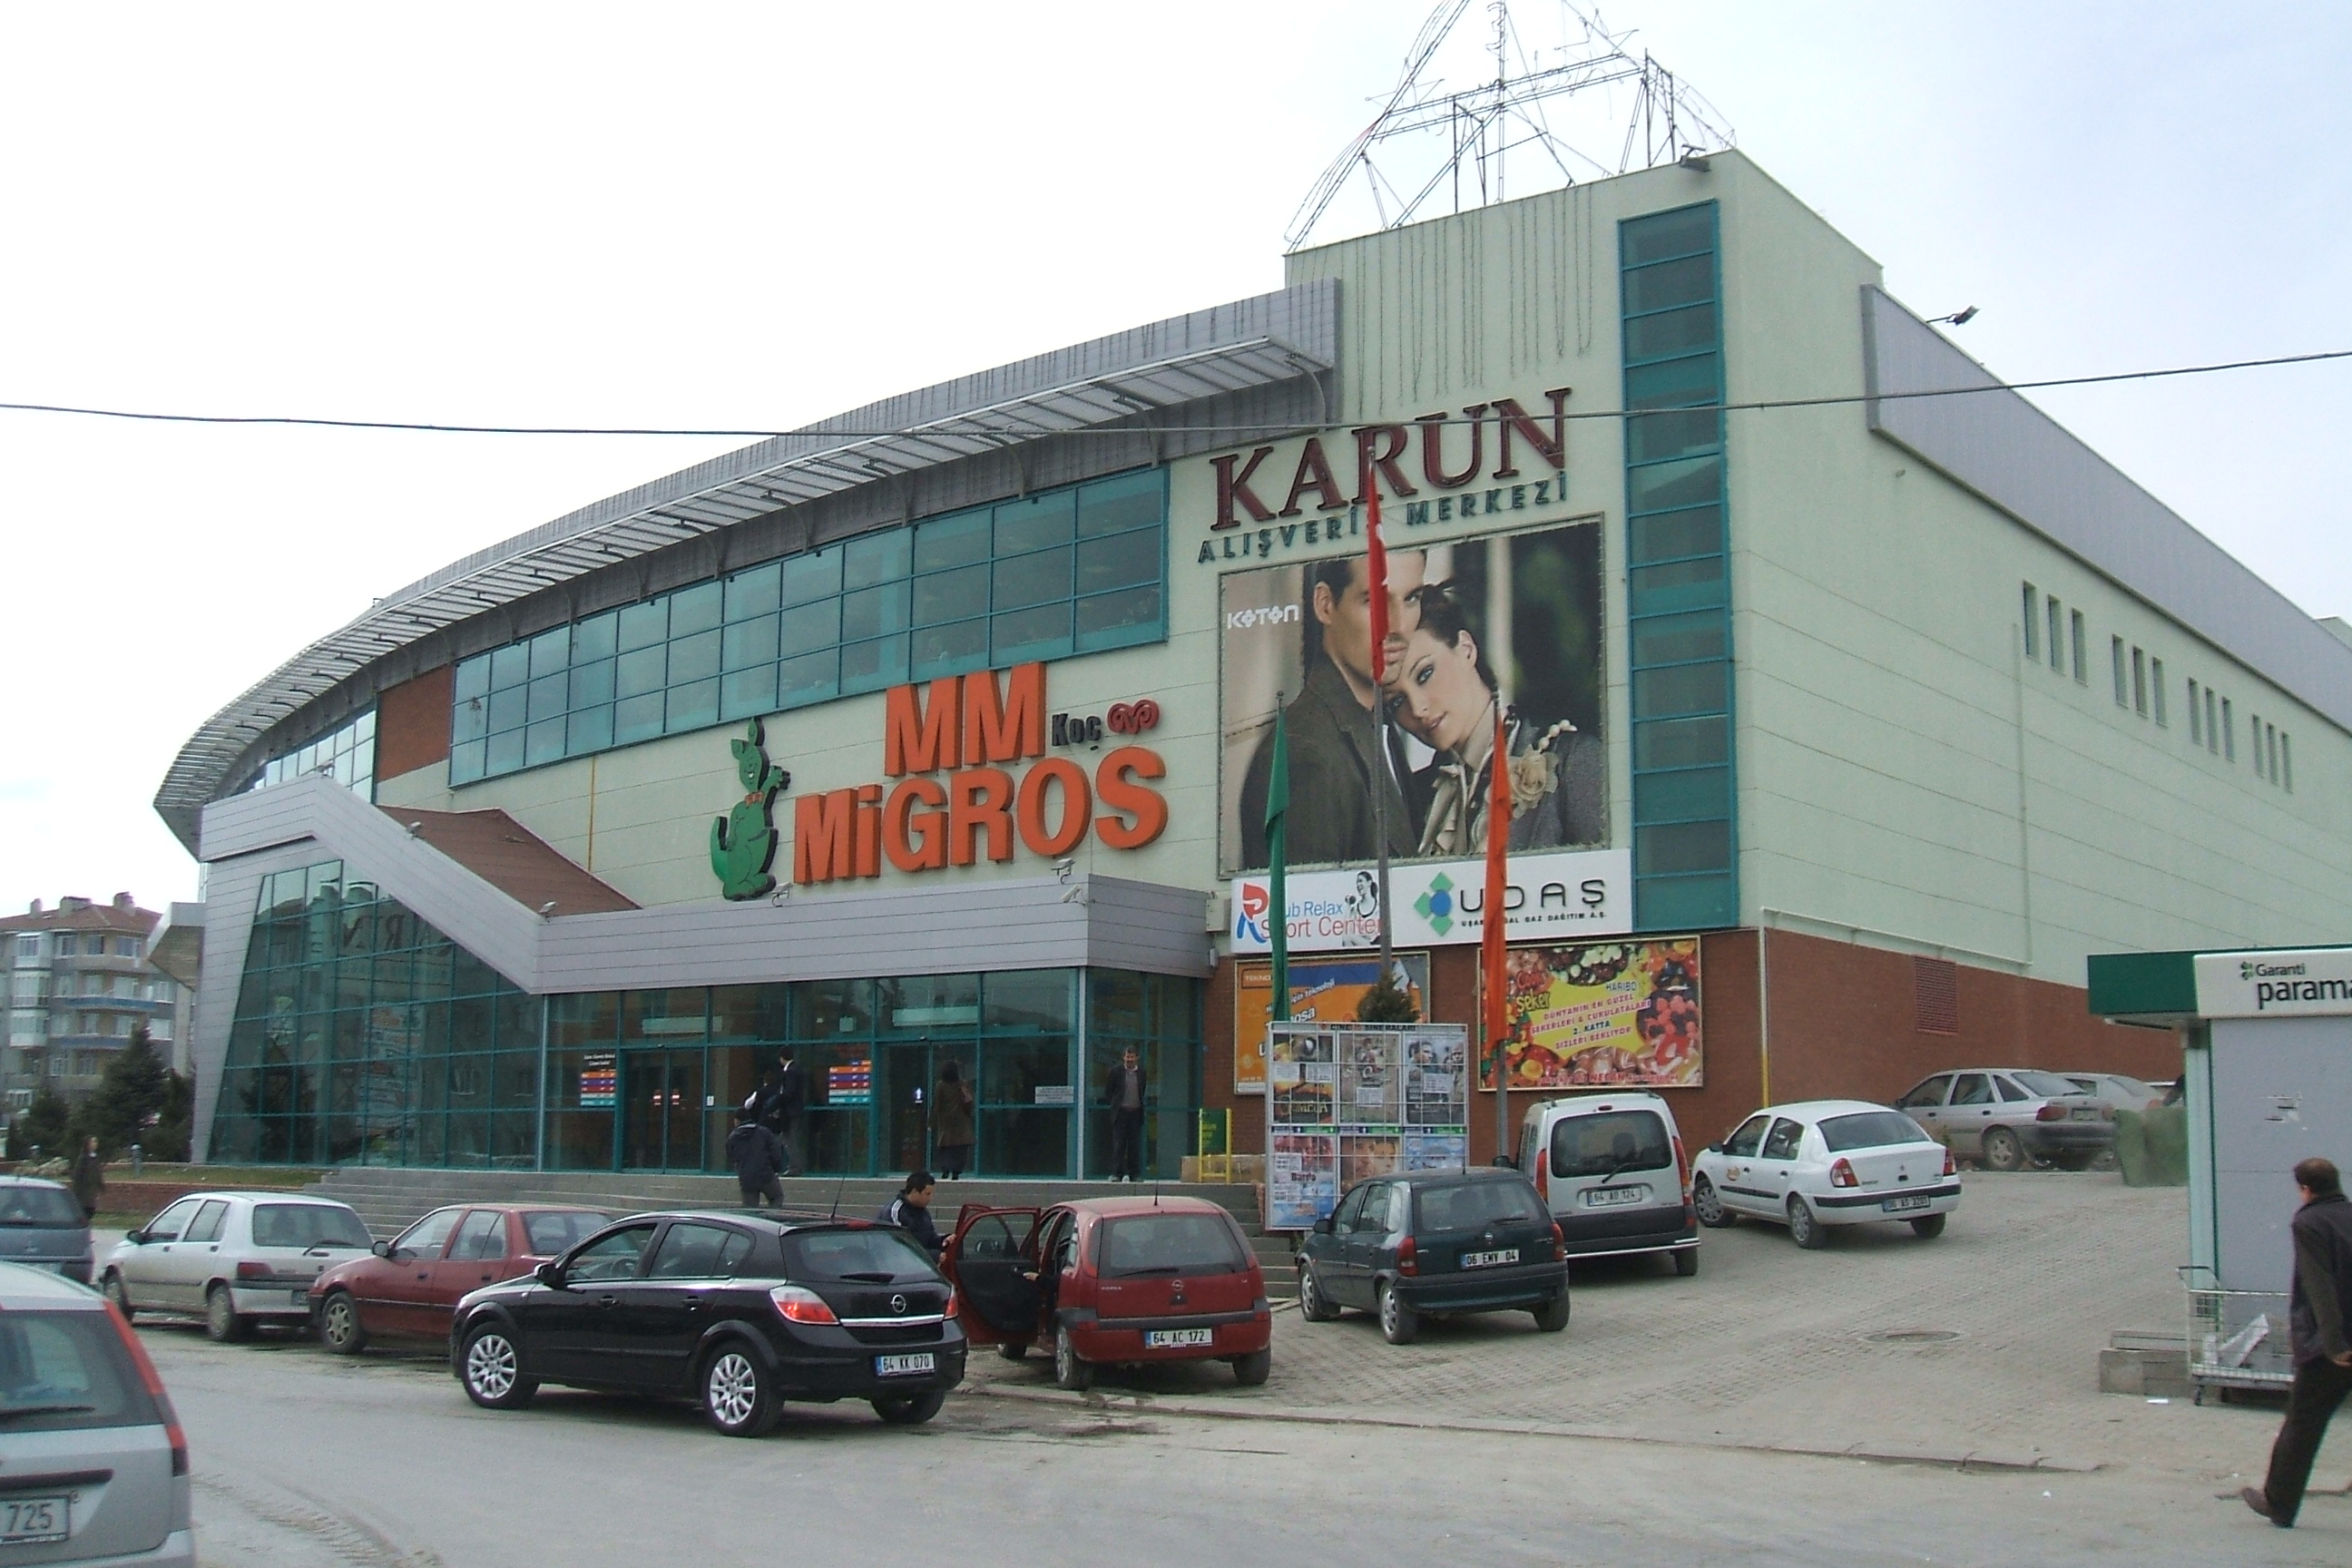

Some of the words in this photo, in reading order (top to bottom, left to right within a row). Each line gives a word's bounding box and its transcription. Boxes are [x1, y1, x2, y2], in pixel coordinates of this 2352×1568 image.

[1210, 387, 1573, 532] KARUN
[1198, 505, 1370, 564] ALIŞVERİ
[884, 661, 1046, 778] MM
[1051, 712, 1102, 751] Koç
[1304, 900, 1343, 916] Relax
[1260, 918, 1311, 939] Sort
[2256, 962, 2306, 977] Garanti
[1583, 1021, 1611, 1034] KATTA
[1466, 1254, 1477, 1266] 06
[1505, 1250, 1516, 1261] 04
[1153, 1333, 1165, 1344] 64
[1171, 1331, 1184, 1343] AC
[1189, 1330, 1205, 1342] 172
[883, 1357, 895, 1371] 64
[899, 1355, 910, 1369] KK
[914, 1355, 929, 1368] 070
[7, 1503, 53, 1532] 725
